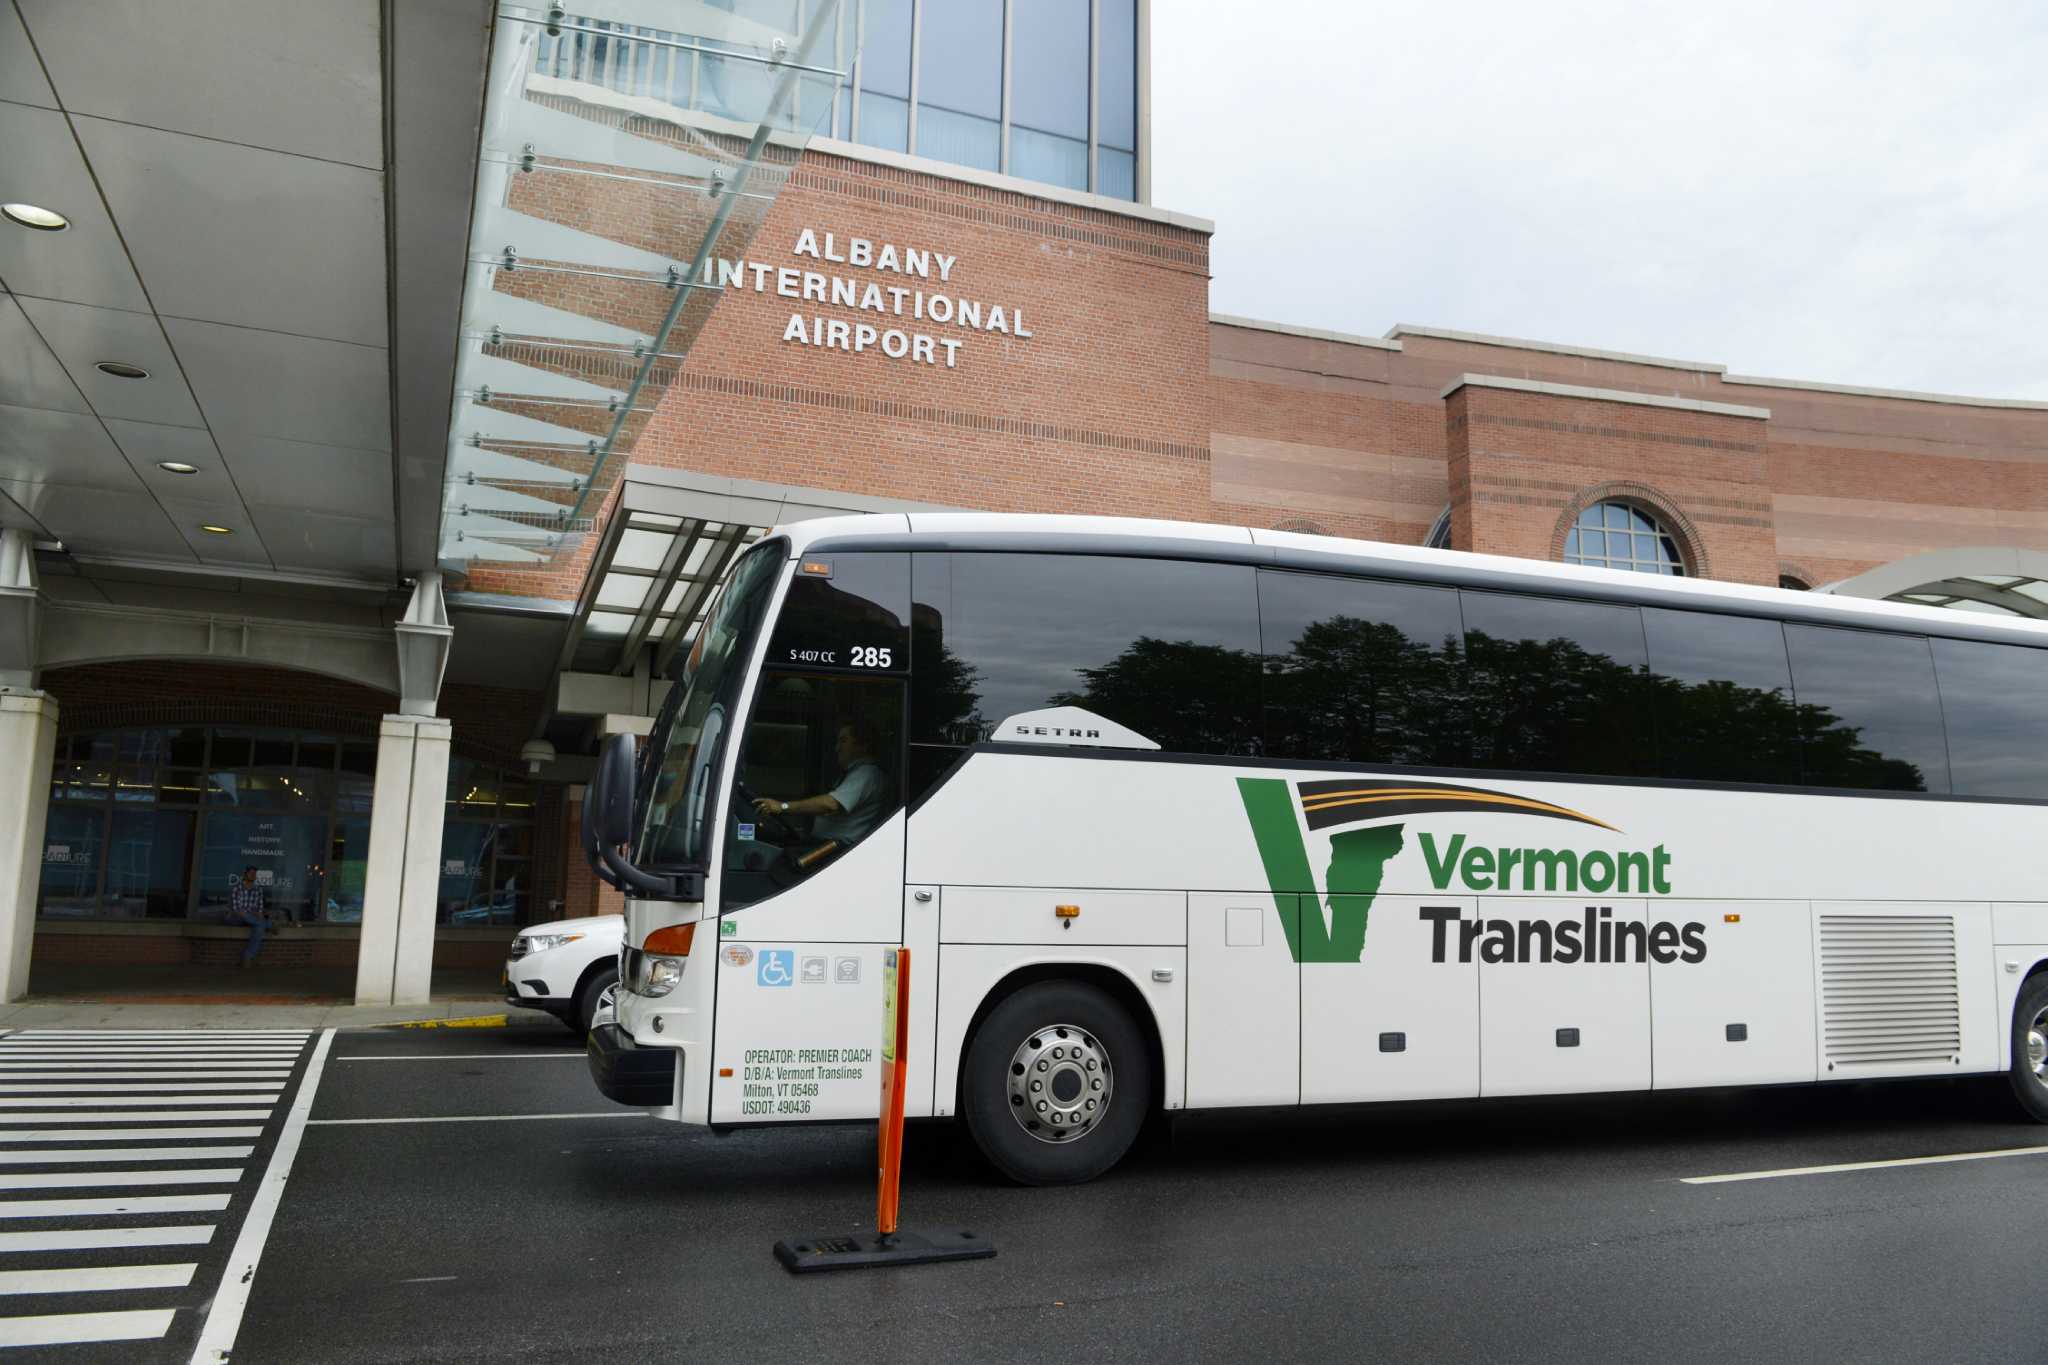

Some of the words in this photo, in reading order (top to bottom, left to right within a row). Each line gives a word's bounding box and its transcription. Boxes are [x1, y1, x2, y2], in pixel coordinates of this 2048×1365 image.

[793, 228, 957, 282] ALBANY
[703, 257, 1033, 338] INTERNATIONAL
[783, 314, 962, 368] AIRPORT
[790, 649, 798, 660] S
[799, 650, 819, 662] 407
[820, 651, 836, 663] CC
[850, 646, 892, 668] 285
[1016, 725, 1100, 738] SETRA
[1417, 832, 1671, 895] Vermont
[1419, 906, 1708, 965] Translines
[744, 1050, 797, 1064] OPERATOR:
[798, 1049, 839, 1063] PREMIER
[841, 1049, 872, 1062] COACH
[744, 1067, 775, 1081] D/B/A:
[777, 1066, 814, 1080] Vermont
[818, 1066, 862, 1079] Translines
[743, 1084, 775, 1098] Milton,
[777, 1084, 789, 1097] VT
[790, 1084, 819, 1096] 05468
[742, 1100, 775, 1114] USDOT:
[777, 1100, 811, 1113] 490436
